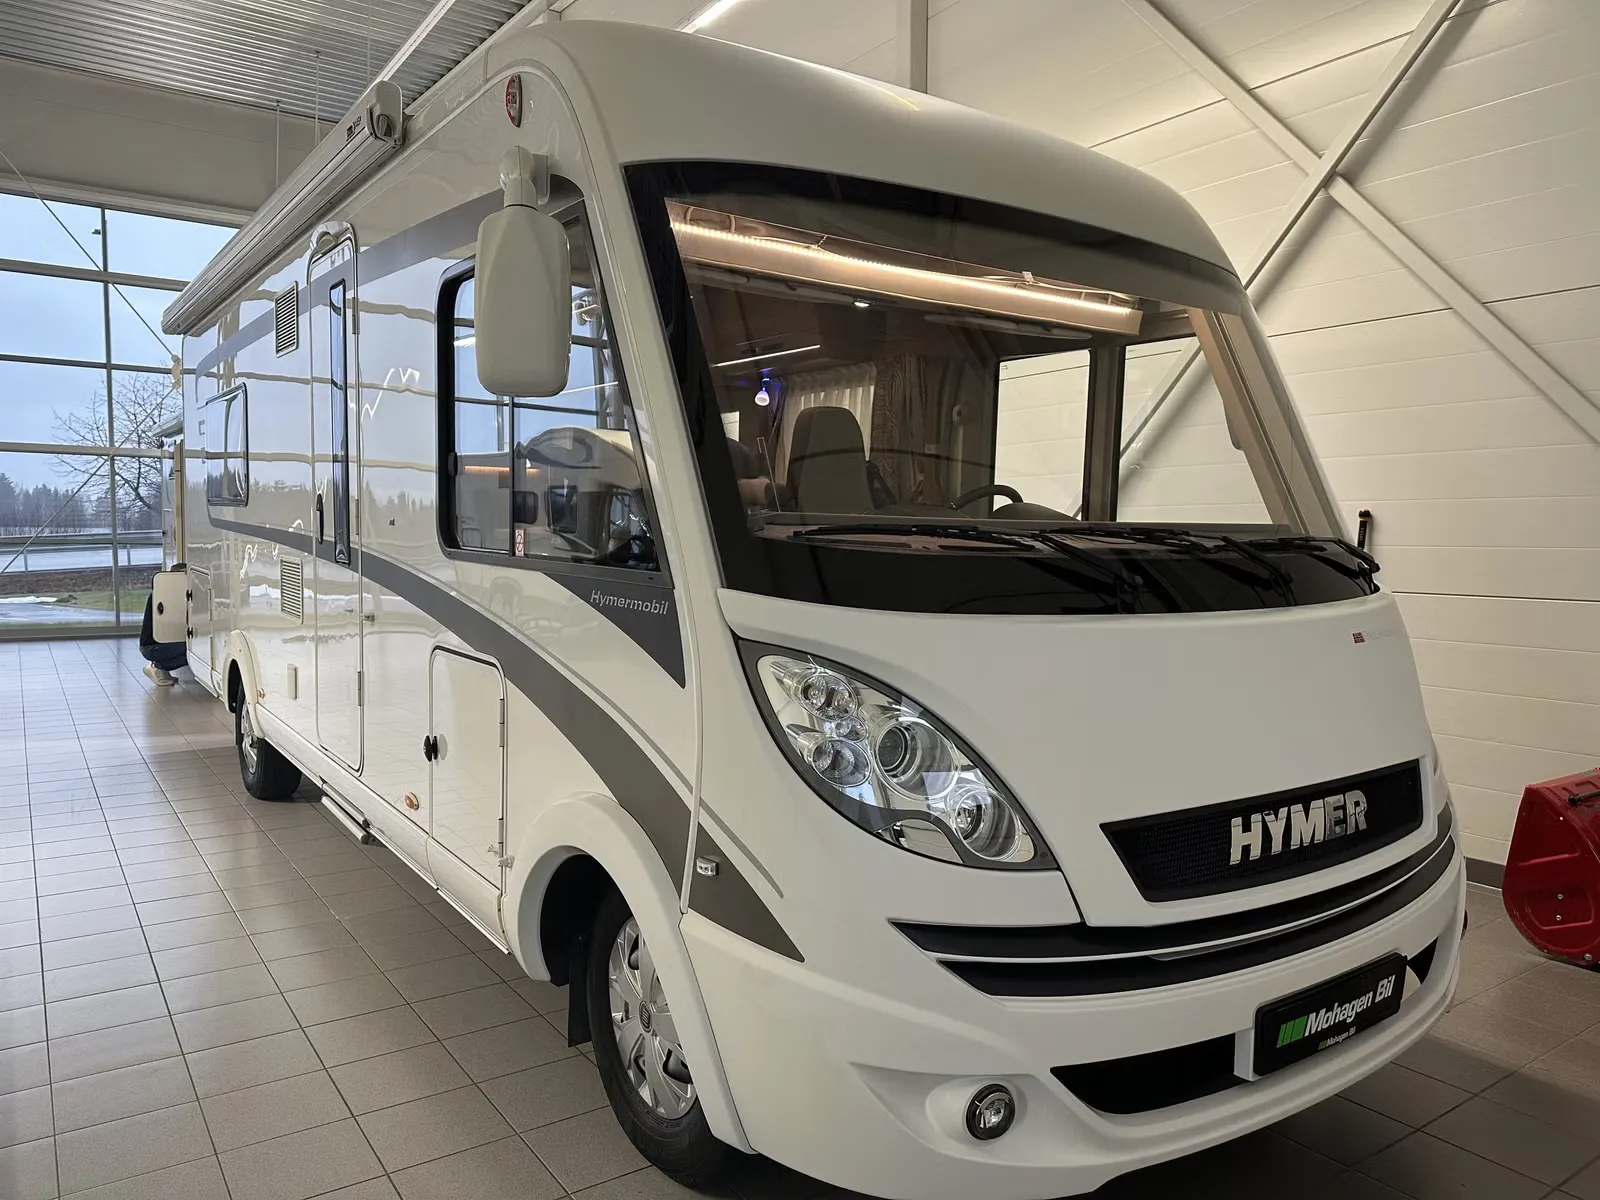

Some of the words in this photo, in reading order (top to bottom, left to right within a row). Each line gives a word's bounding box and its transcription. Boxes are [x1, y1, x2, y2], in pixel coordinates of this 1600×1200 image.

[590, 590, 669, 615] Hymermobil
[1229, 789, 1368, 866] HYMER
[1304, 991, 1373, 1037] Mohagen
[1375, 974, 1396, 1003] Bil
